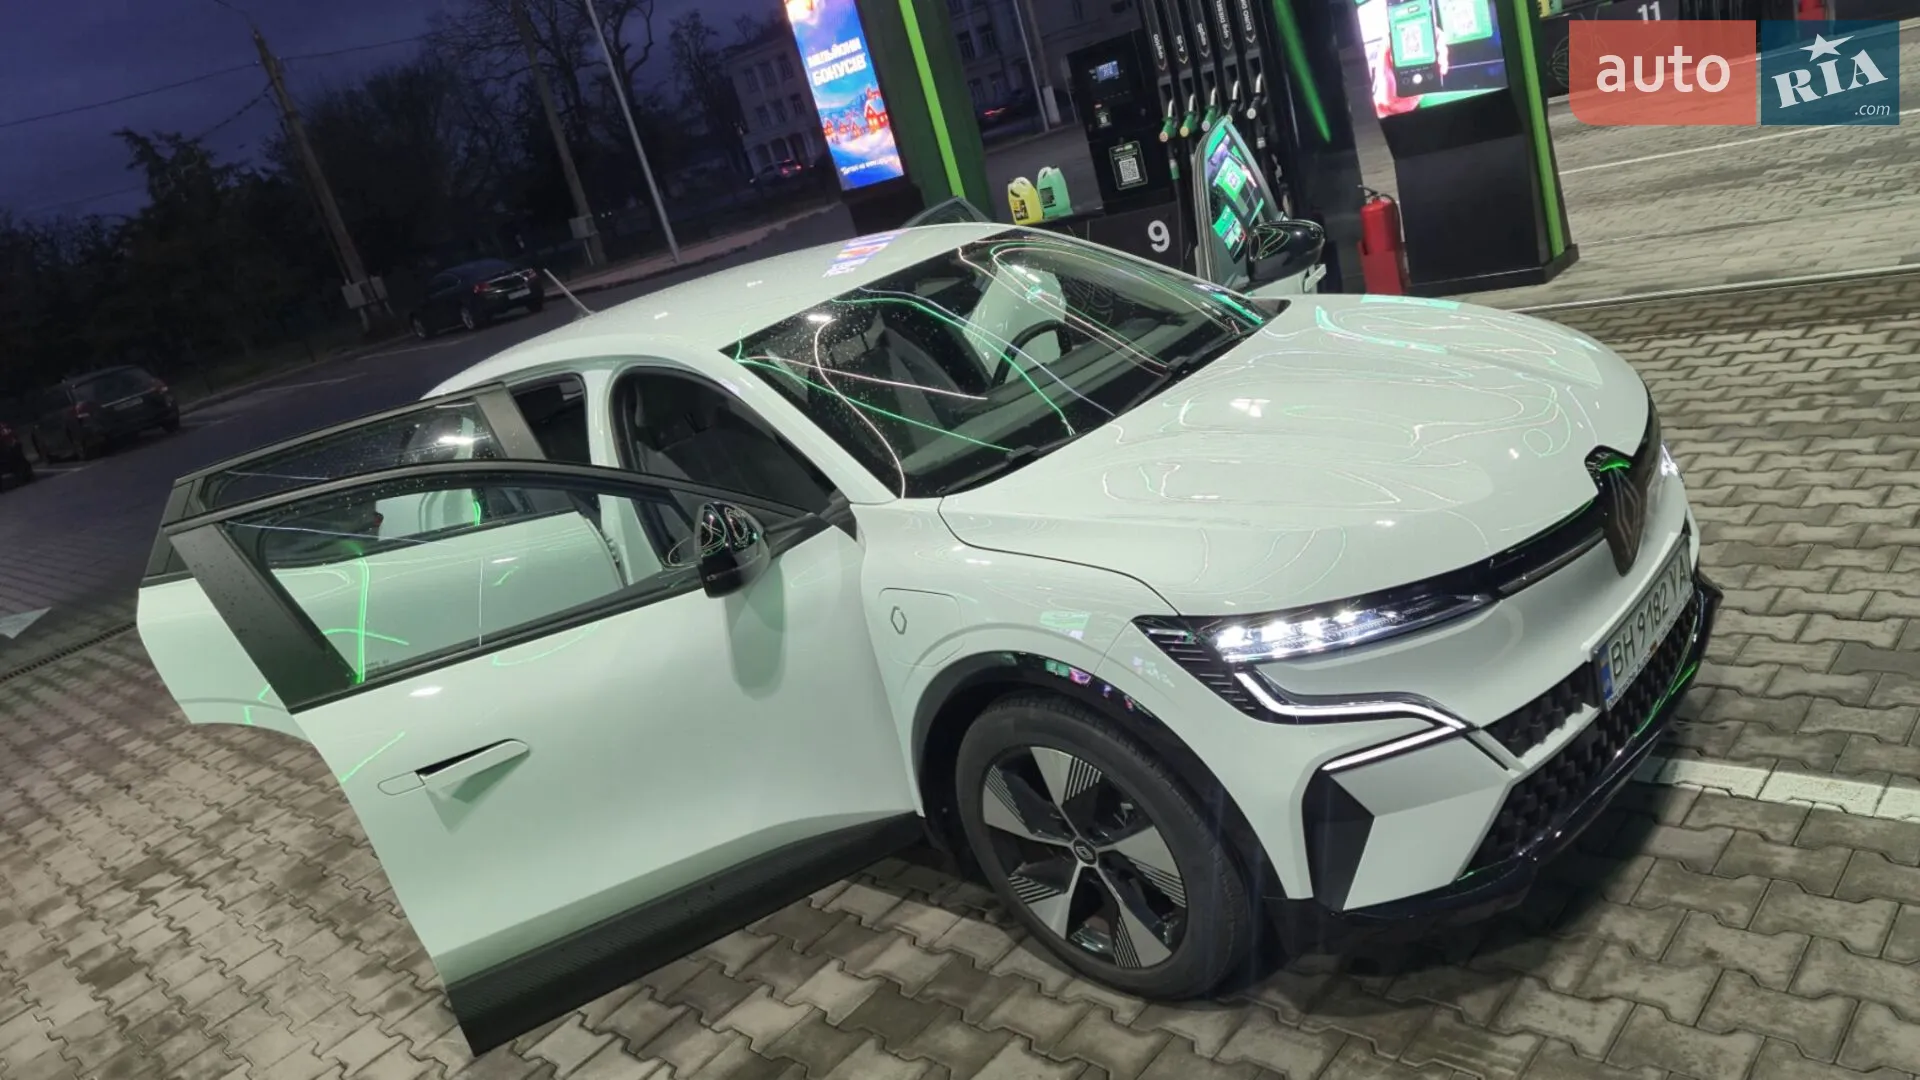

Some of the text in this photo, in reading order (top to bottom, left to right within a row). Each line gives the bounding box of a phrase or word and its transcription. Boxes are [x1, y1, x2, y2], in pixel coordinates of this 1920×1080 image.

[1637, 1, 1661, 24] 11
[1147, 220, 1171, 253] 9
[1610, 625, 1636, 679] BH
[1637, 582, 1669, 644] 9182
